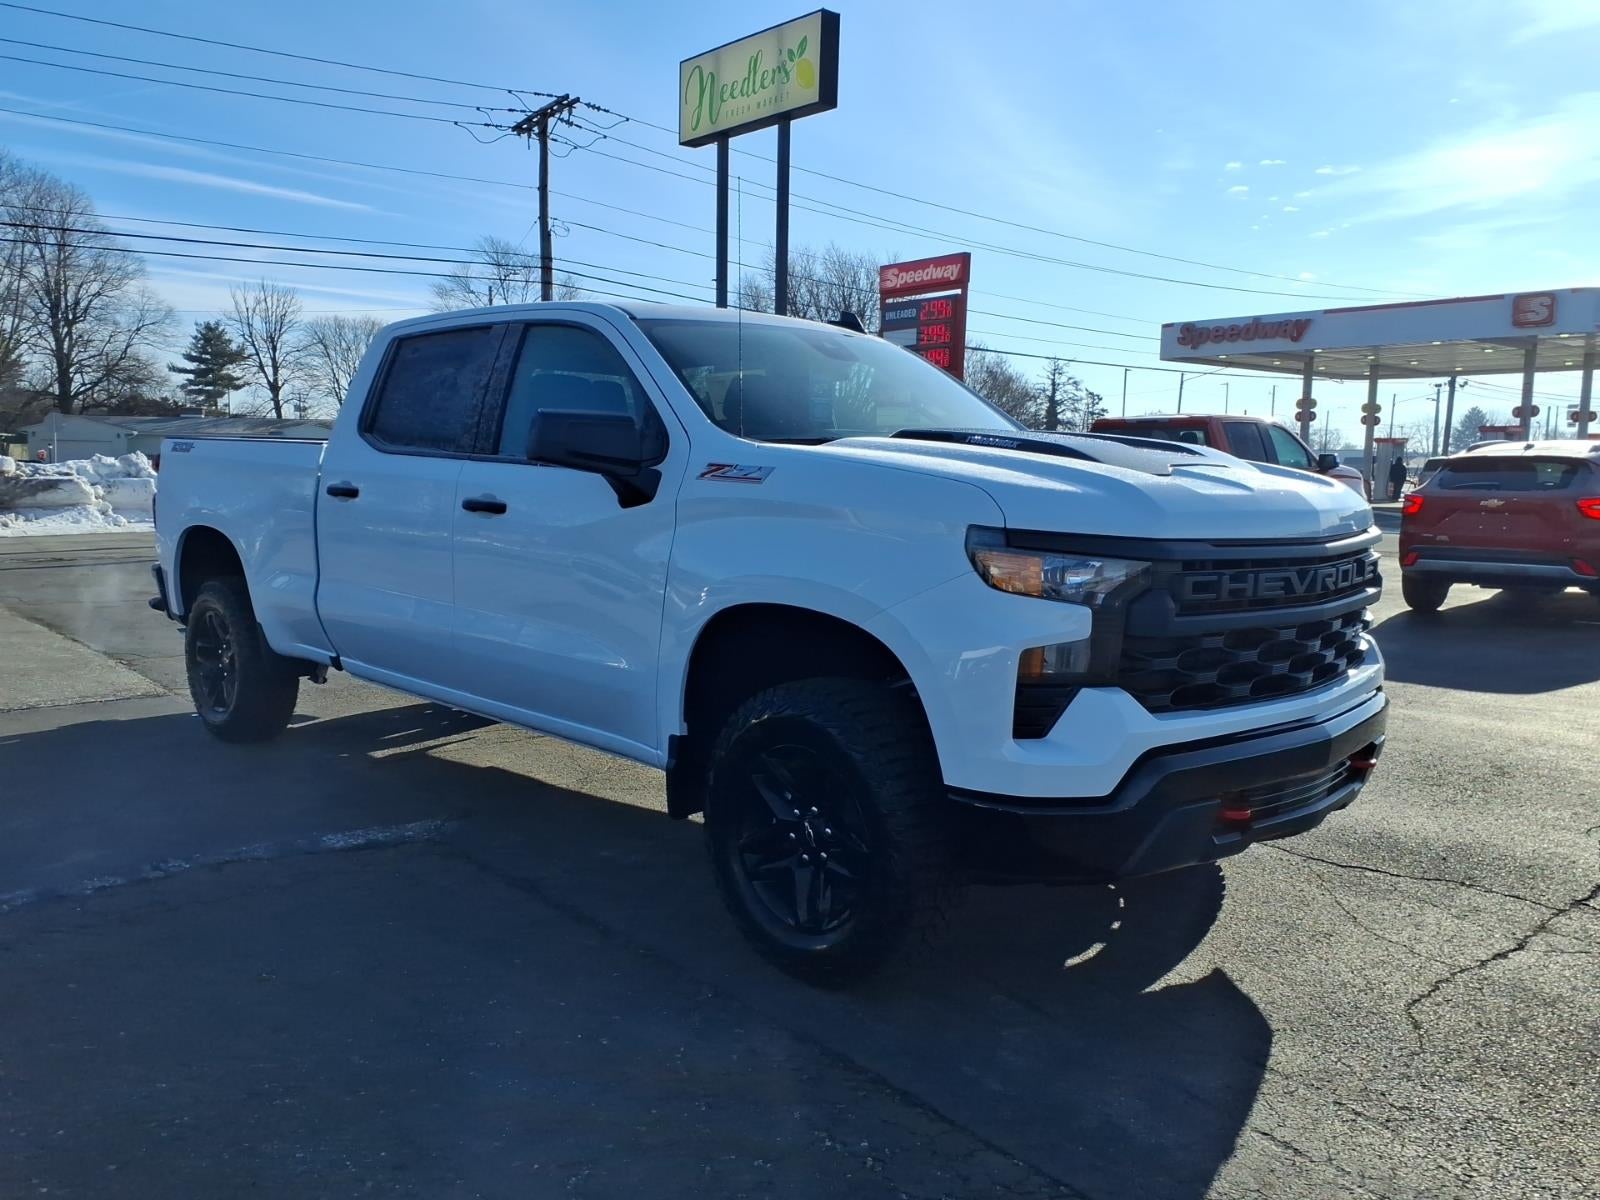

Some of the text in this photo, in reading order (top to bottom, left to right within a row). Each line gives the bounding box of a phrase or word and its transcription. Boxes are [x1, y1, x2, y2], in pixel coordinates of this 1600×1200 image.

[685, 49, 794, 131] Needler's
[882, 263, 961, 288] Speedway
[885, 308, 917, 320] UNLEADED
[1177, 317, 1312, 349] Speedway
[1184, 558, 1377, 600] CHEVROLE
